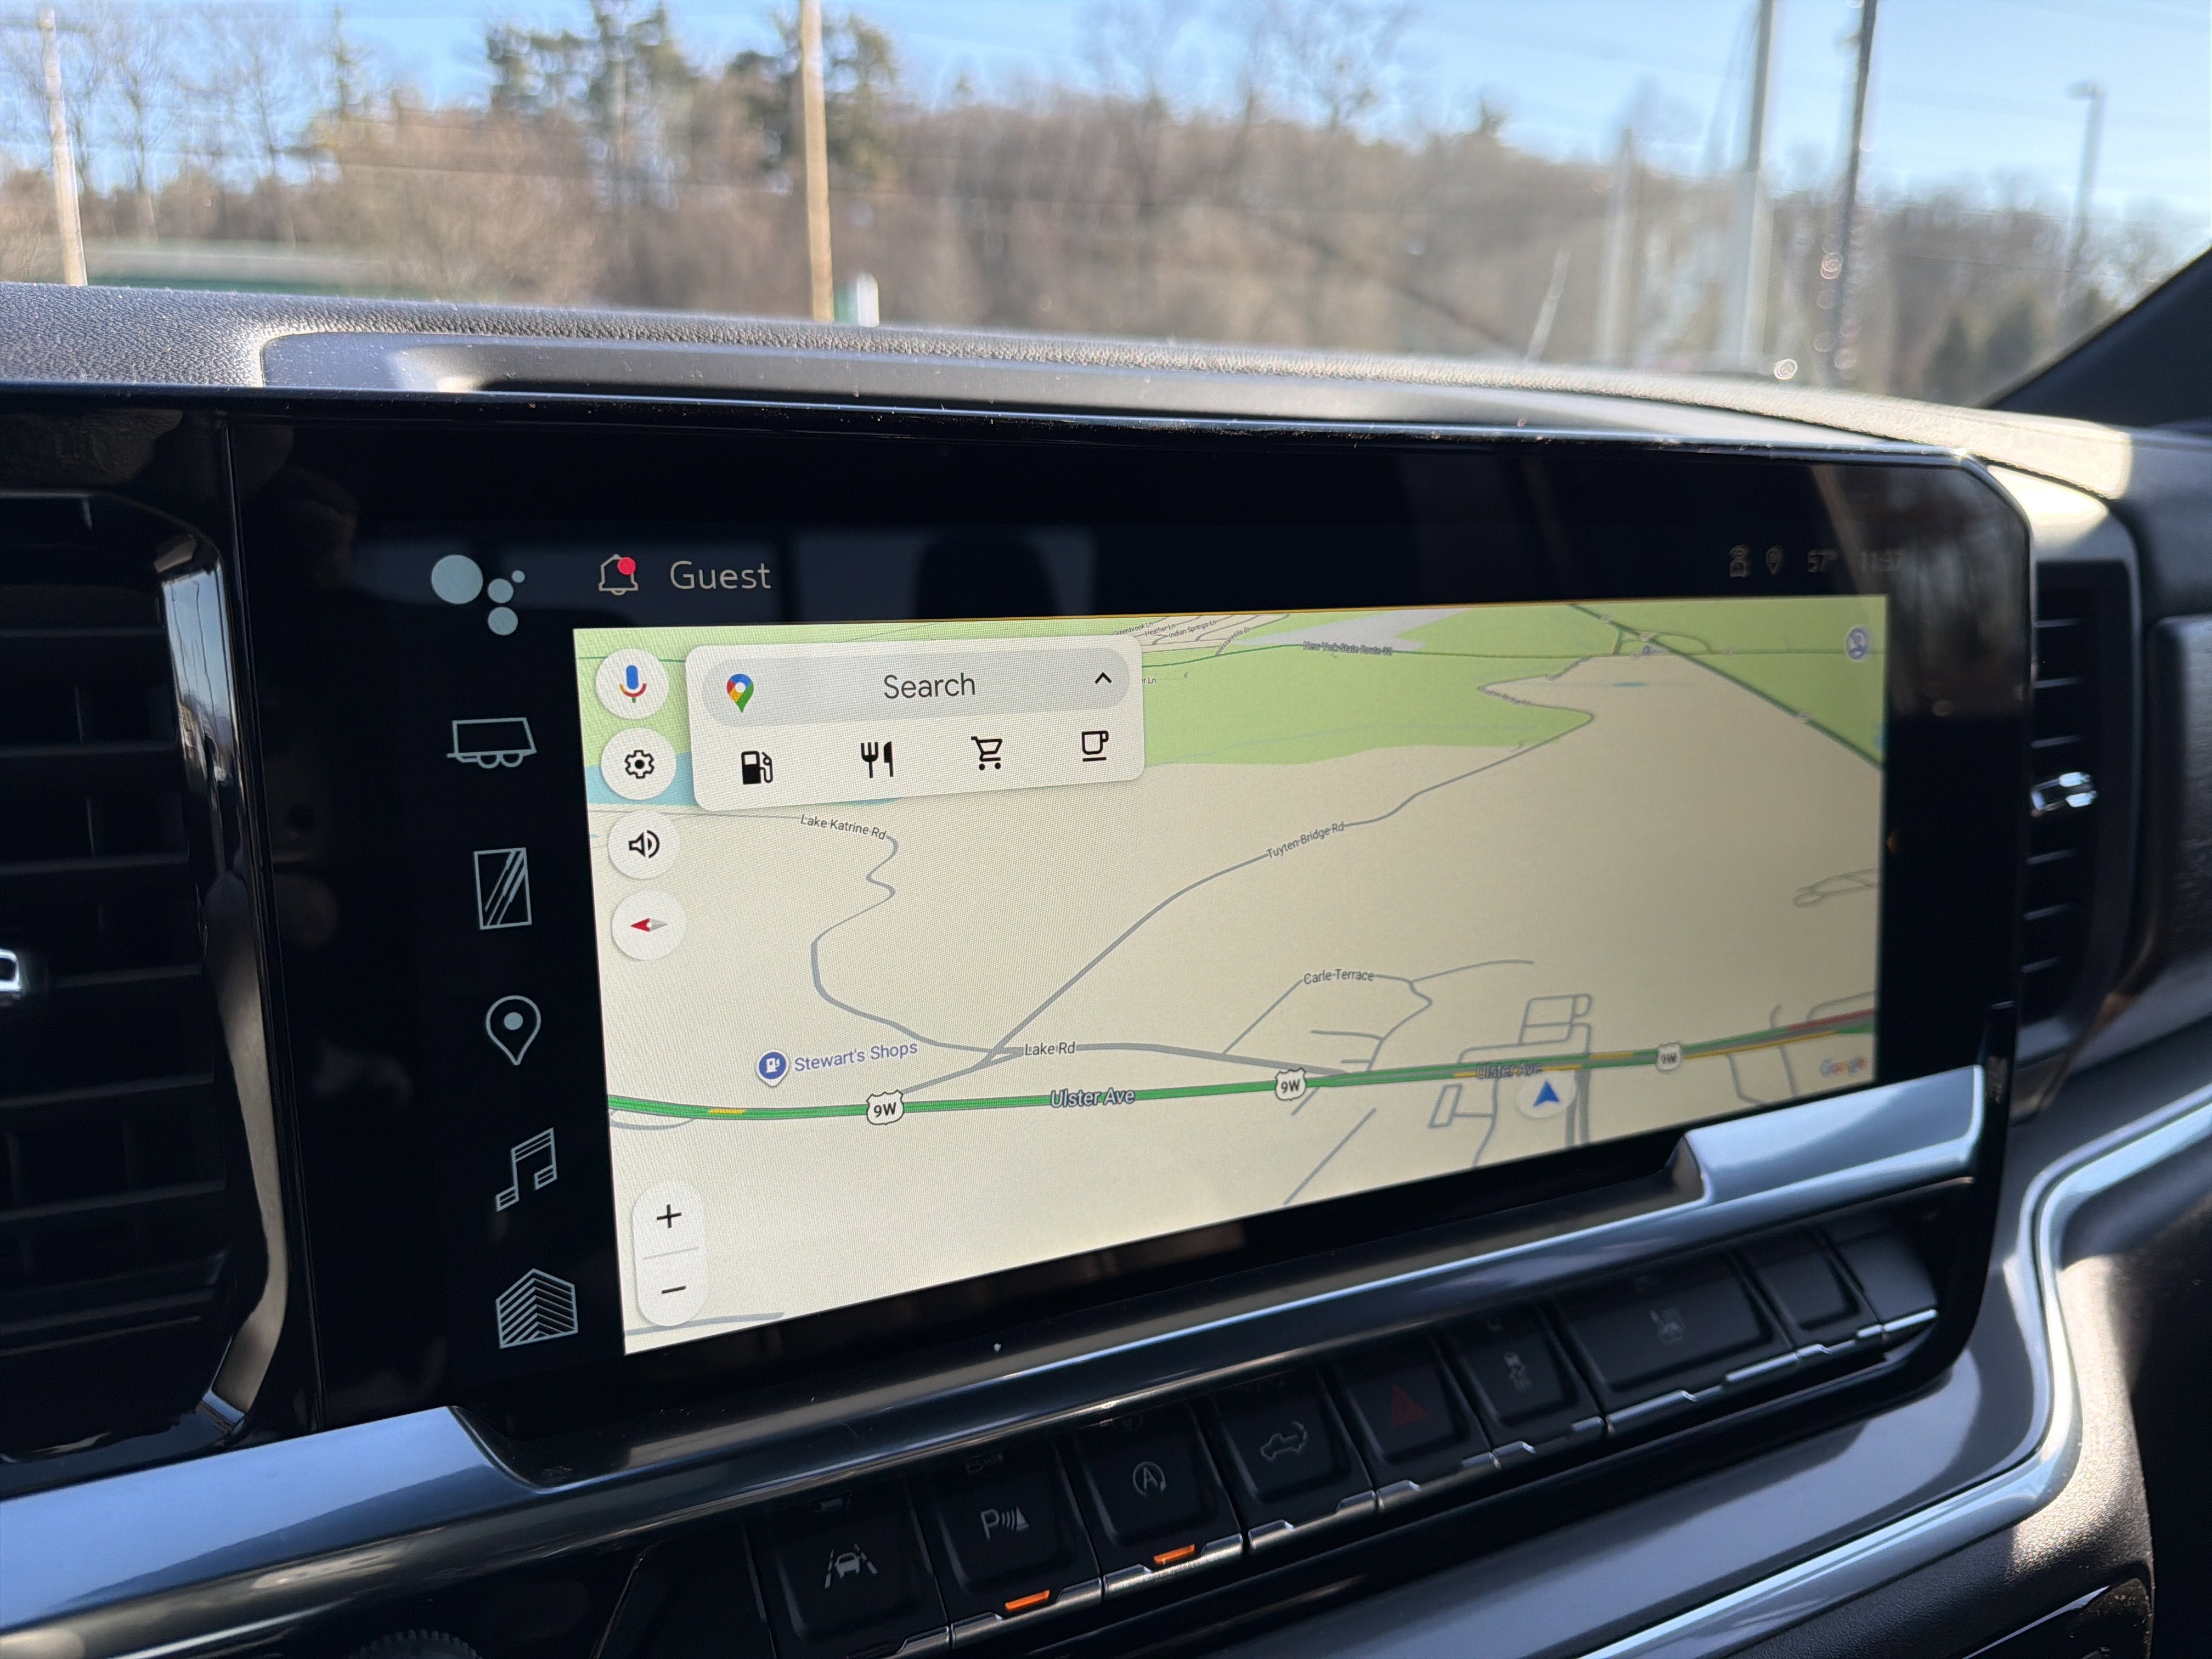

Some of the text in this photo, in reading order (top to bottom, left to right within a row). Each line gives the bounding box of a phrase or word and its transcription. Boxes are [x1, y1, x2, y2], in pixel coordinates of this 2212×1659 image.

[670, 560, 772, 590] Guest
[1145, 626, 1167, 636] Heather
[1169, 629, 1187, 638] Indian
[1187, 623, 1209, 633] Springs
[883, 672, 976, 699] Search
[800, 814, 887, 840] Lake Katrine Rd
[1266, 821, 1345, 859] Tuyten Bridge Rd
[1304, 968, 1374, 984] Carle Terrace
[794, 1043, 918, 1071] Stewart's Shops
[1025, 1041, 1075, 1056] Lake Rd
[1476, 1062, 1543, 1079] Ulster Ave
[1280, 1079, 1300, 1093] 9W
[1051, 1087, 1136, 1108] Ulster Ave
[873, 1102, 897, 1118] 9W
